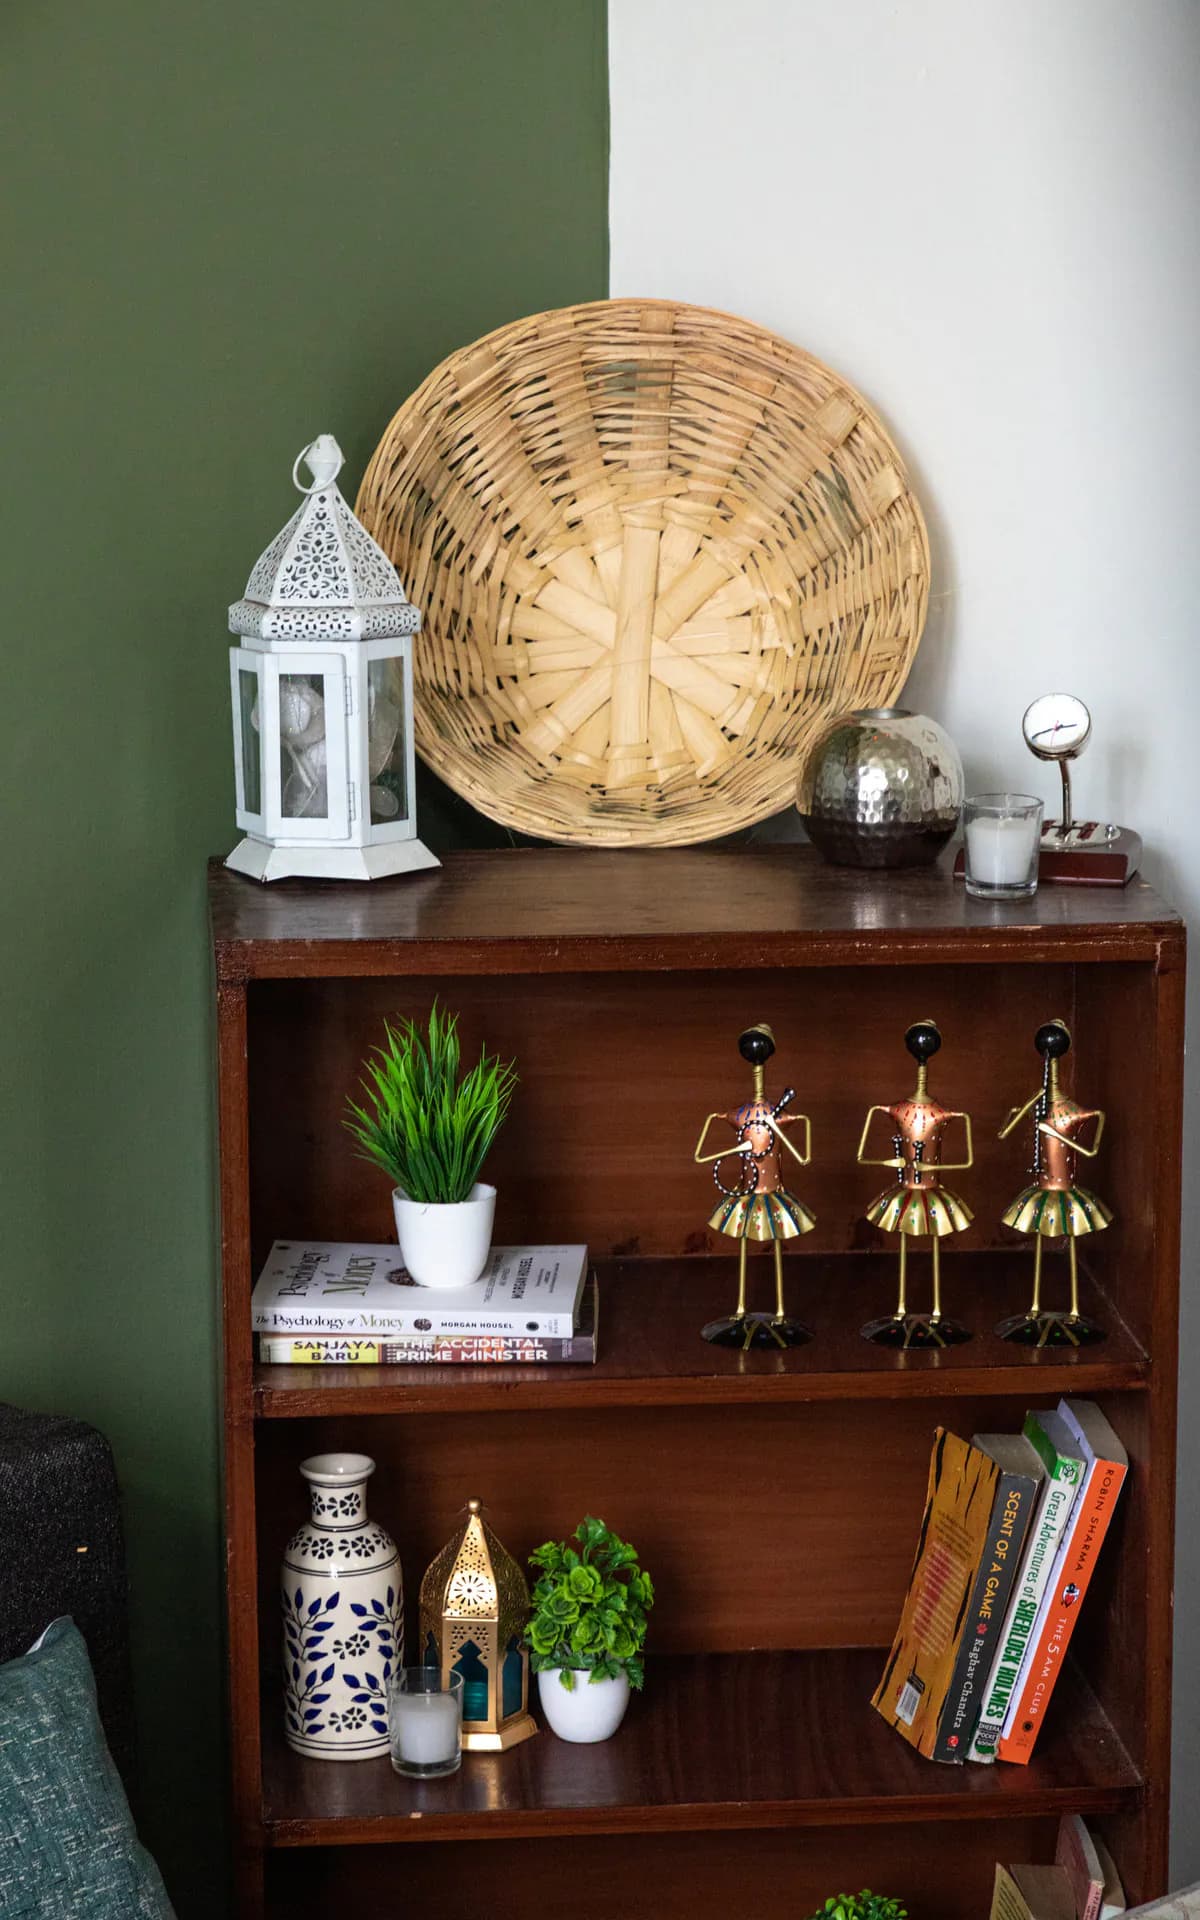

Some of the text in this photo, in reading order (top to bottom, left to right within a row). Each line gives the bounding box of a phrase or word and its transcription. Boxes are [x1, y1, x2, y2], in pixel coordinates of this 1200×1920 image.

[273, 1314, 345, 1329] Psychology
[359, 1314, 404, 1331] Money
[441, 1321, 477, 1329] MORGAN
[293, 1341, 376, 1350] SANJAYA
[401, 1339, 543, 1349] THE ACCIDENTAL
[311, 1352, 359, 1361] BARU
[396, 1350, 548, 1361] PRIME MINISTER
[1075, 1469, 1115, 1571] ROBIN SHARMA
[979, 1491, 1021, 1620] SCENT OF A GAME
[986, 1490, 1066, 1719] Great Adventures of SHERLOCK HOLMES
[1029, 1618, 1067, 1715] THE 5 AM CLUB
[953, 1639, 984, 1728] Raghav Chandra
